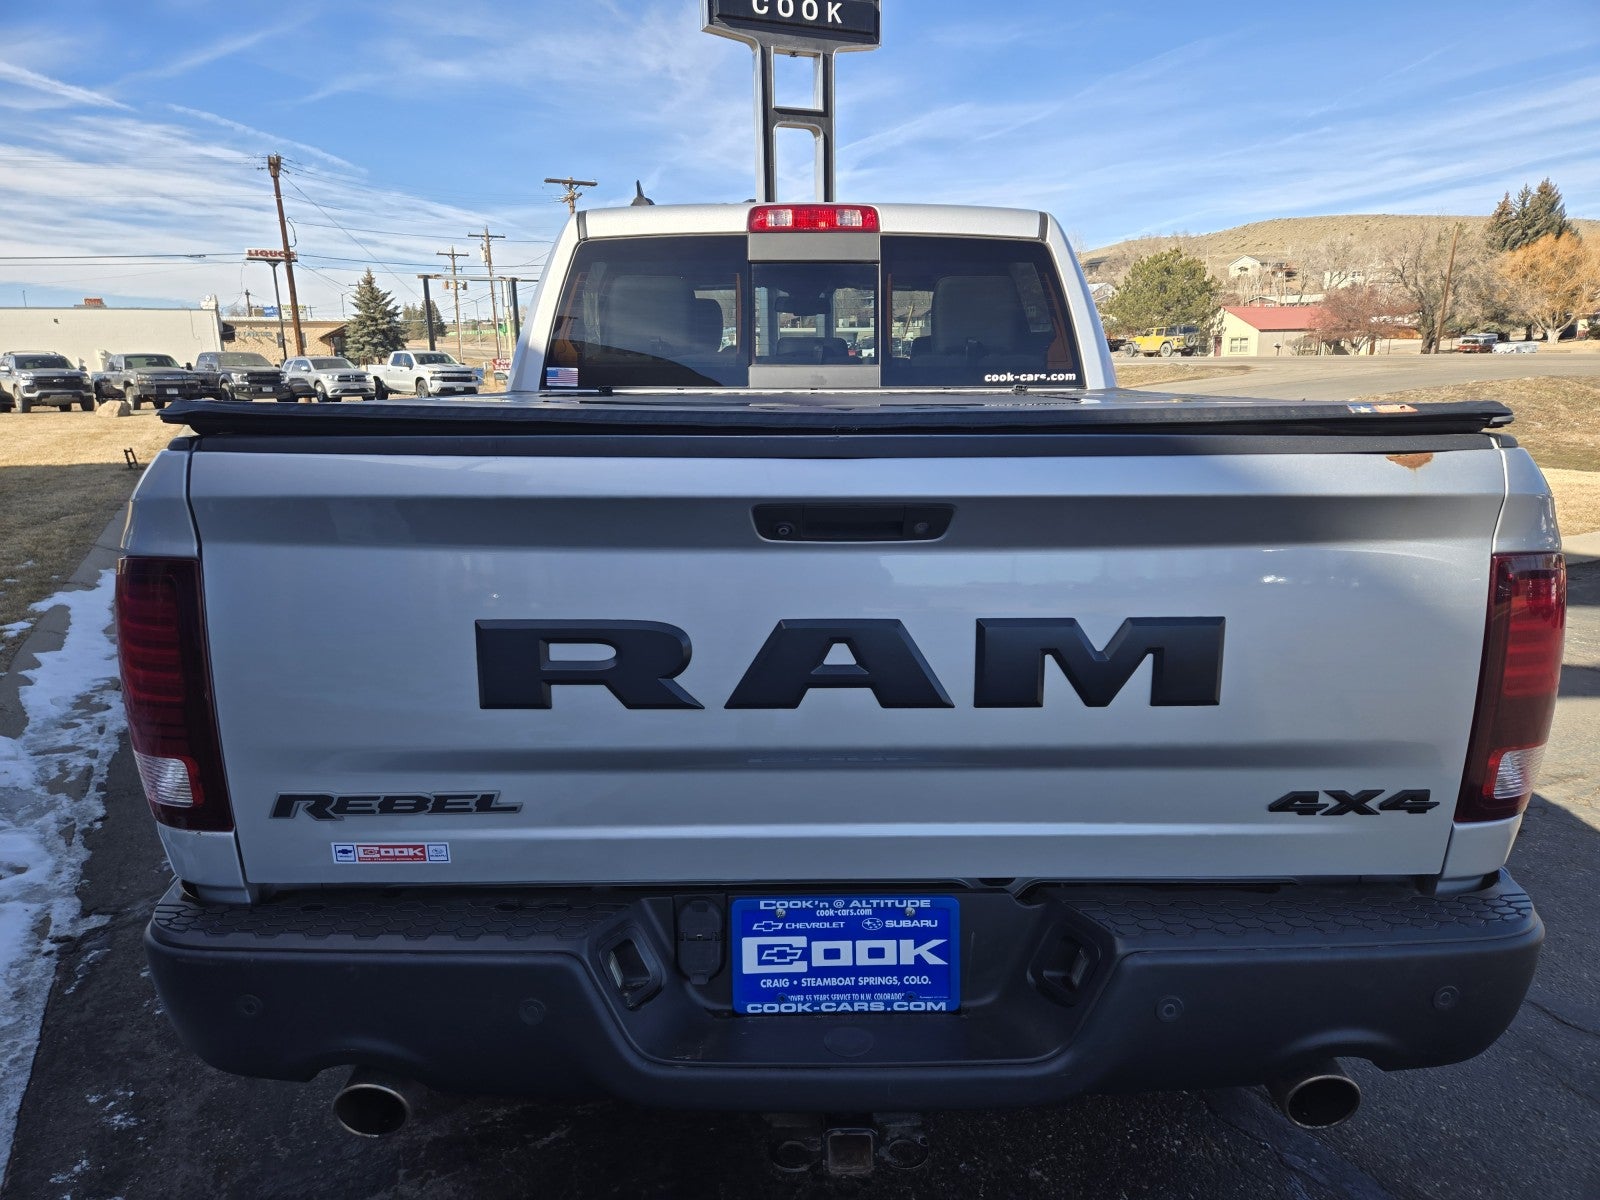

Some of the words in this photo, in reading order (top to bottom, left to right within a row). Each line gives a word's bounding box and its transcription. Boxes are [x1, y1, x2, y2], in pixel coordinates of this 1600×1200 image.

[752, 0, 842, 24] COOK
[984, 372, 1076, 382] cook-cars.com
[475, 616, 1226, 710] RAM
[268, 790, 523, 821] REBEL
[1268, 789, 1440, 816] 4X4
[358, 846, 424, 858] COOK
[760, 900, 829, 910] COOK'n
[833, 899, 845, 909] @
[849, 899, 931, 909] ALTITUDE
[815, 908, 873, 917] cook-cars.com
[785, 921, 846, 929] CHEVROLET
[884, 919, 938, 928] SUBARU
[741, 936, 949, 975] COOK
[760, 978, 790, 988] CRAIG
[801, 976, 856, 987] STEAMBOAT
[858, 975, 901, 986] SPRINGS,
[903, 975, 932, 985] COLO.
[747, 1001, 947, 1013] COOK-CARS.COM
